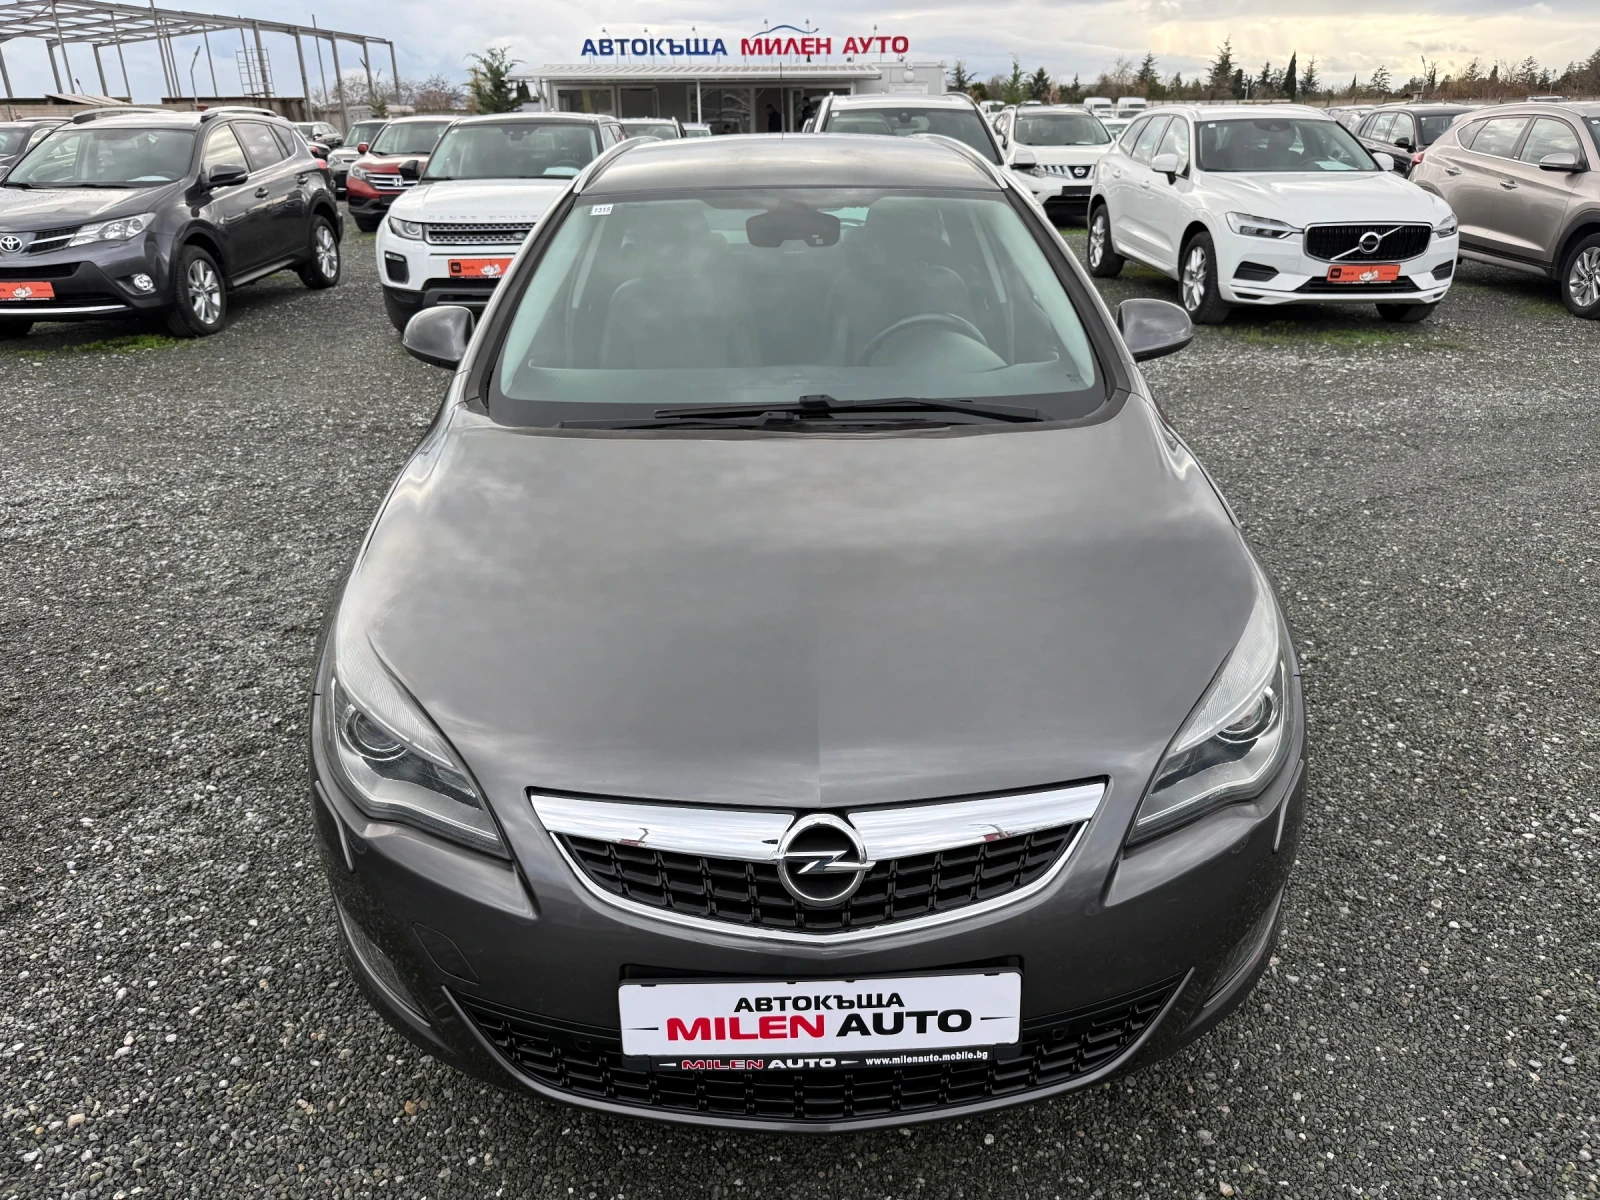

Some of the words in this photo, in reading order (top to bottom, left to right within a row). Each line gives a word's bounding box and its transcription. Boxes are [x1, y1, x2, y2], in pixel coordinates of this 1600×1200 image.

[741, 38, 831, 56] МИЛЕН
[843, 36, 909, 54] АУТО
[666, 1015, 825, 1041] MILEN
[836, 1008, 972, 1037] AUTO
[681, 1059, 764, 1070] MILEN
[767, 1058, 837, 1069] AUTO
[865, 1051, 989, 1066] www.milenauto.mobile.bg
